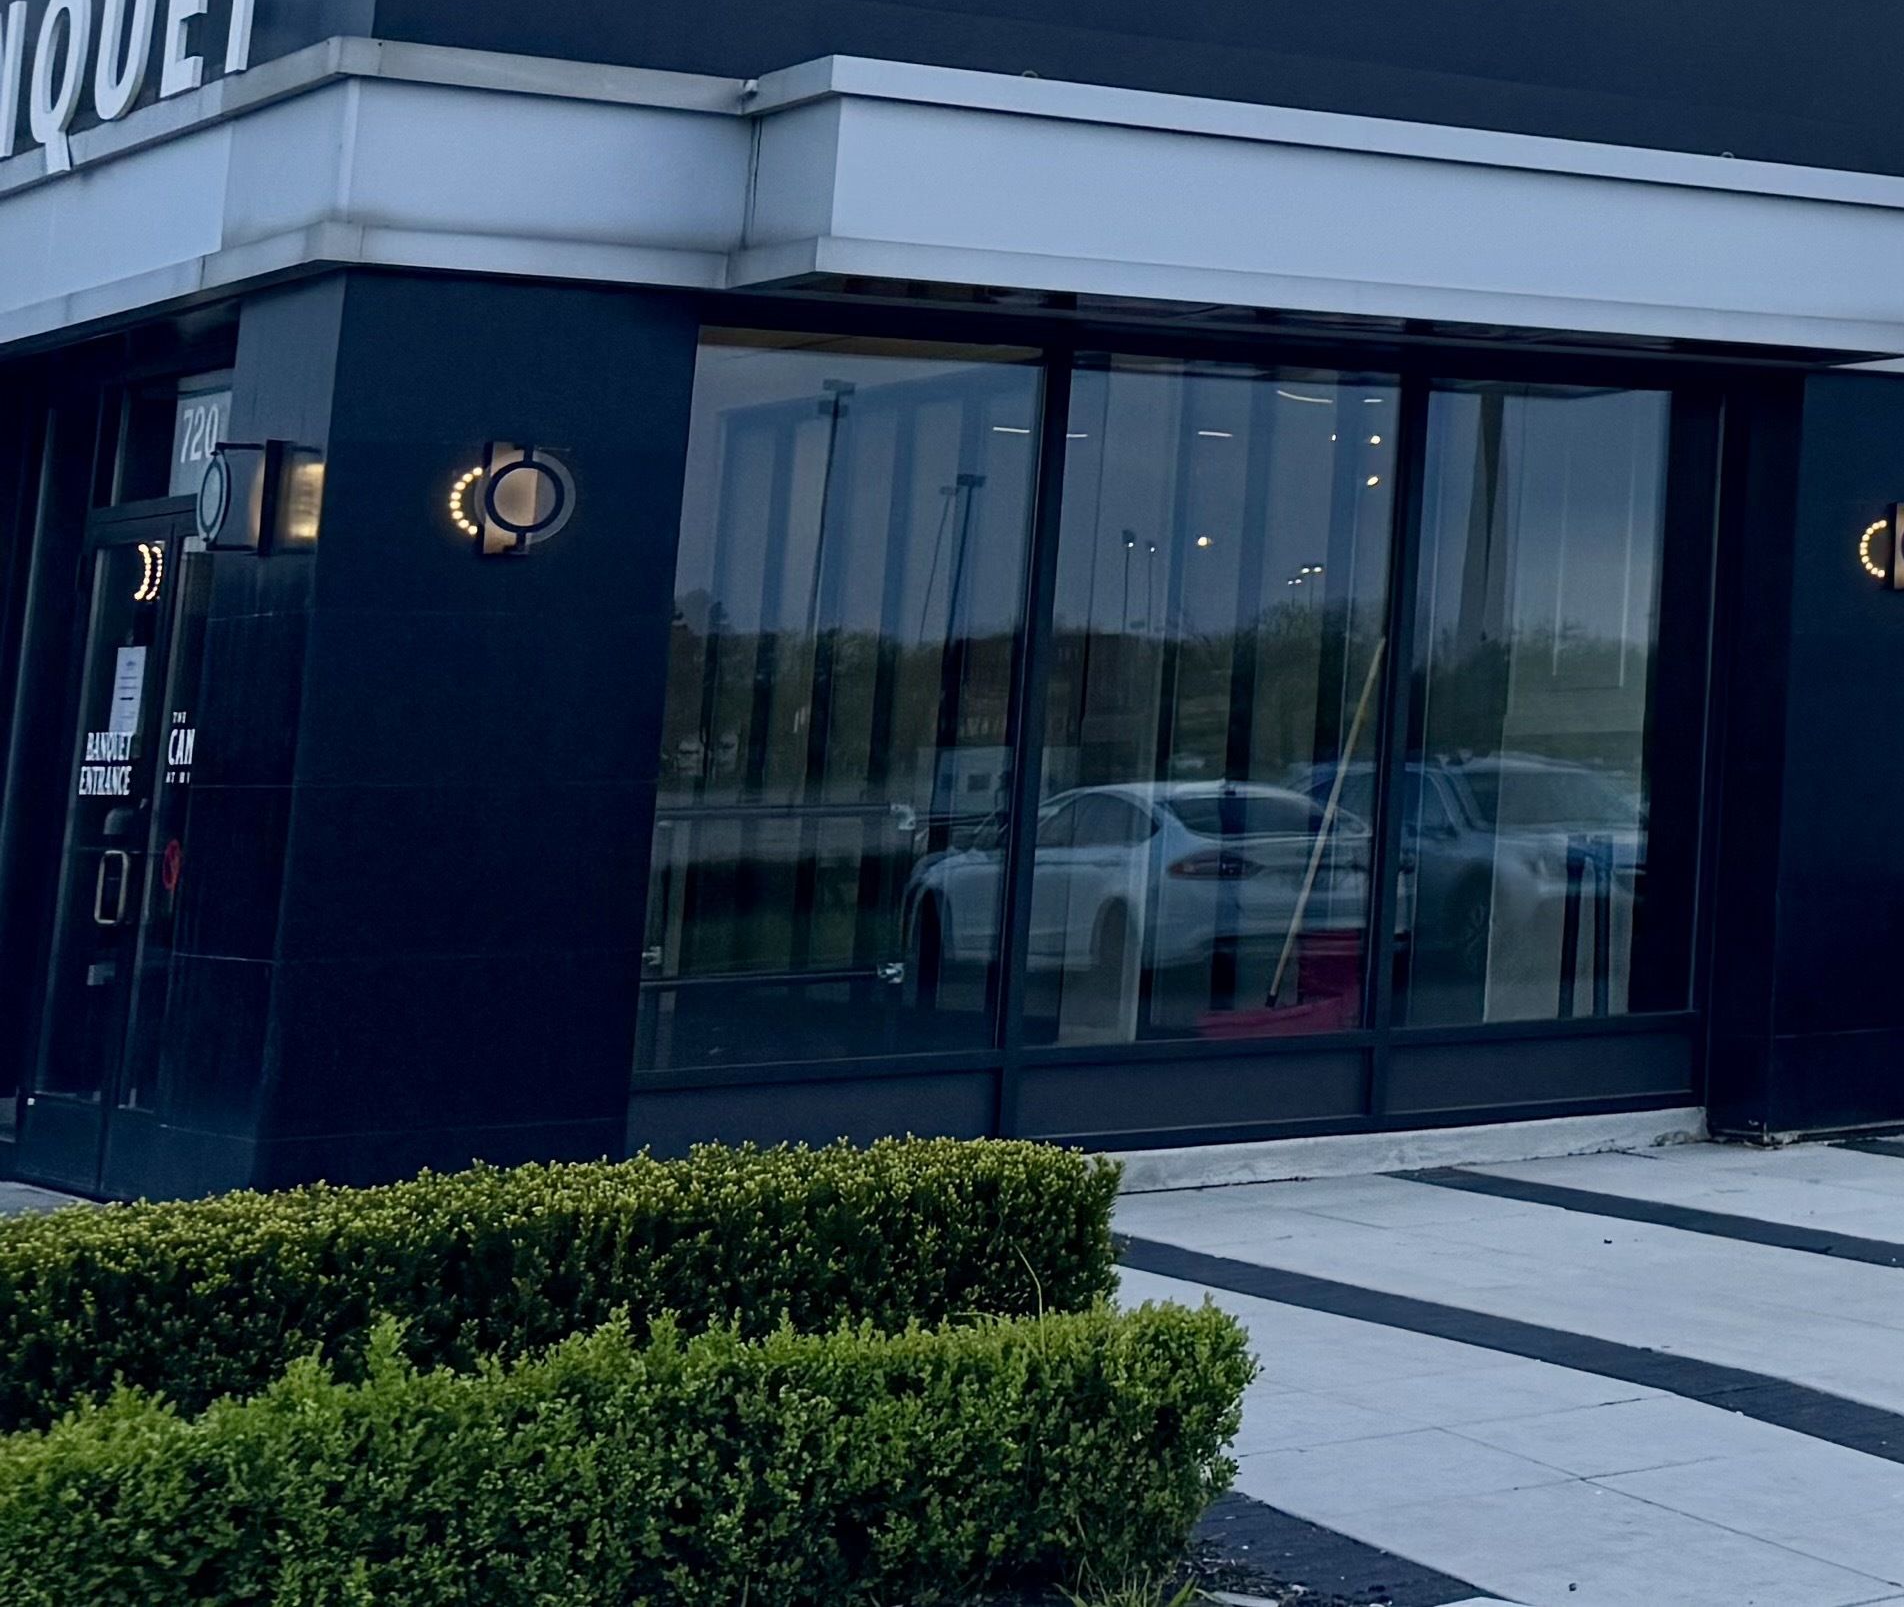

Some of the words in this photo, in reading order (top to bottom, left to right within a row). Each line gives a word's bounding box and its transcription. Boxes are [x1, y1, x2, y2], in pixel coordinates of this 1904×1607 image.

[181, 404, 219, 463] 720
[85, 732, 132, 763] BANQUET
[79, 766, 132, 795] ENTRANCE
